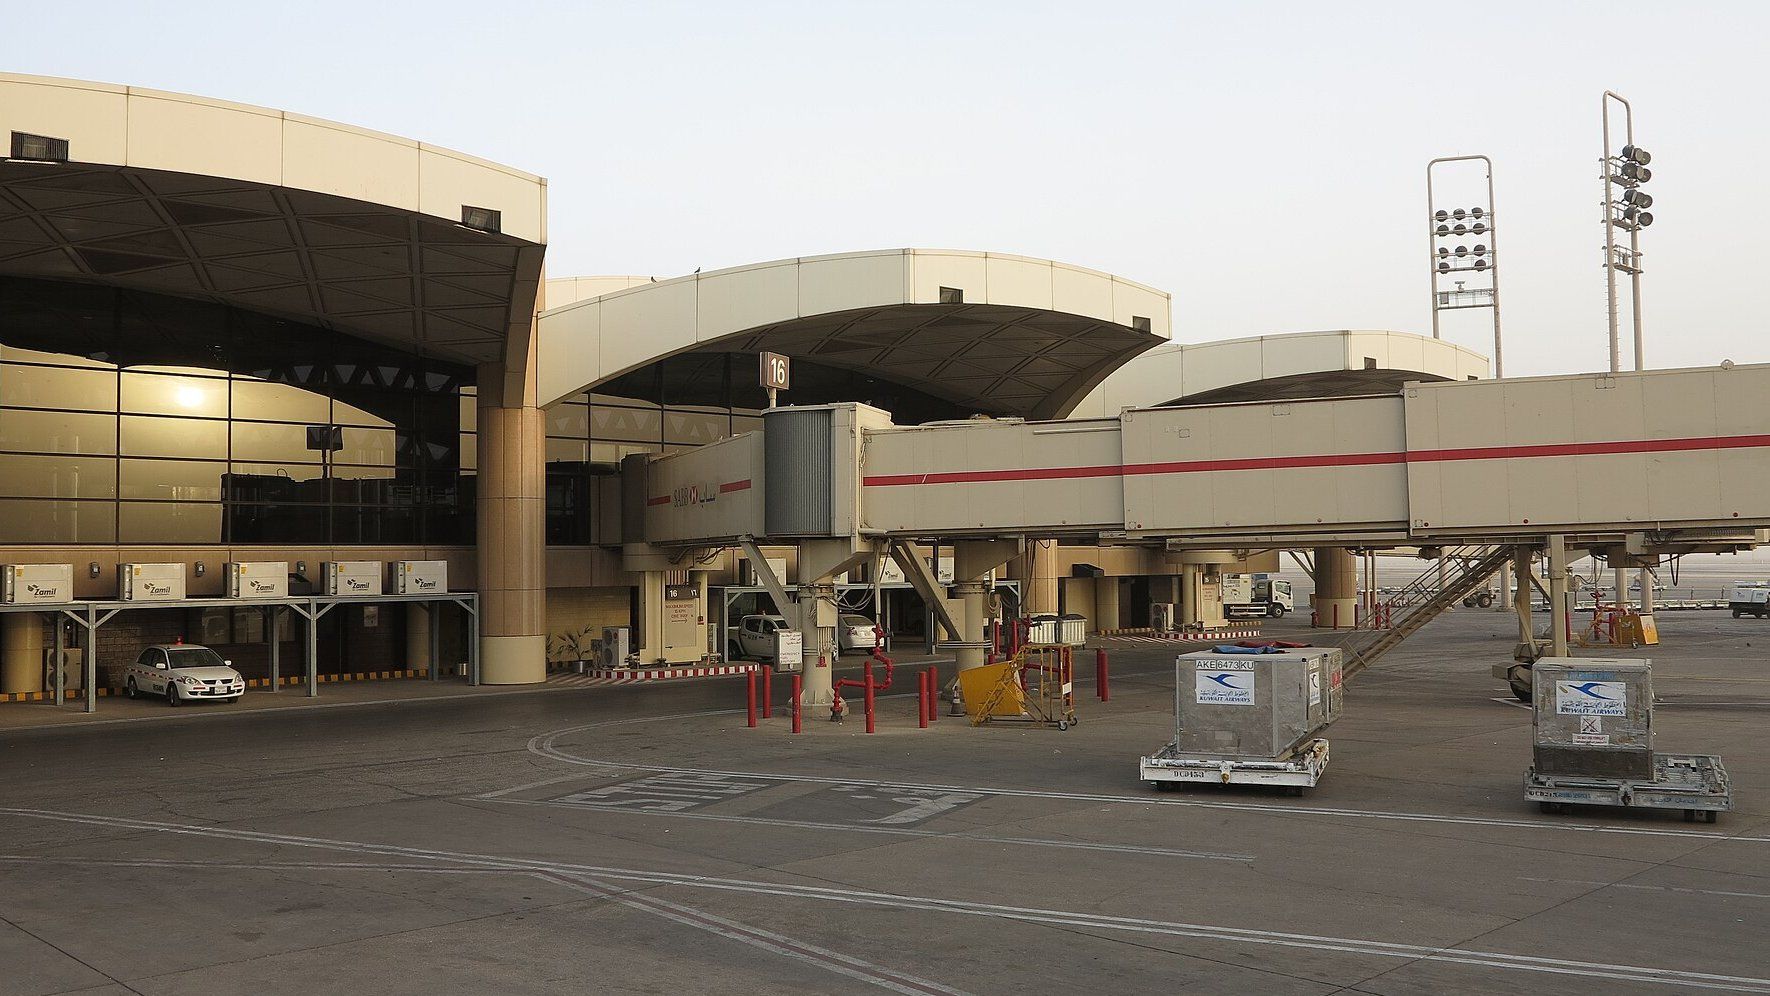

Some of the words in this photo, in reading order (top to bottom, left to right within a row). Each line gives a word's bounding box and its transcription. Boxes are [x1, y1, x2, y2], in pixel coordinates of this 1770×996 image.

[770, 357, 786, 385] 16
[150, 586, 171, 594] Zamil
[256, 583, 275, 591] Zamil
[352, 582, 370, 590] Zamil
[34, 587, 57, 596] Zamil
[669, 589, 678, 598] 16
[1560, 706, 1590, 714] KUWAIT
